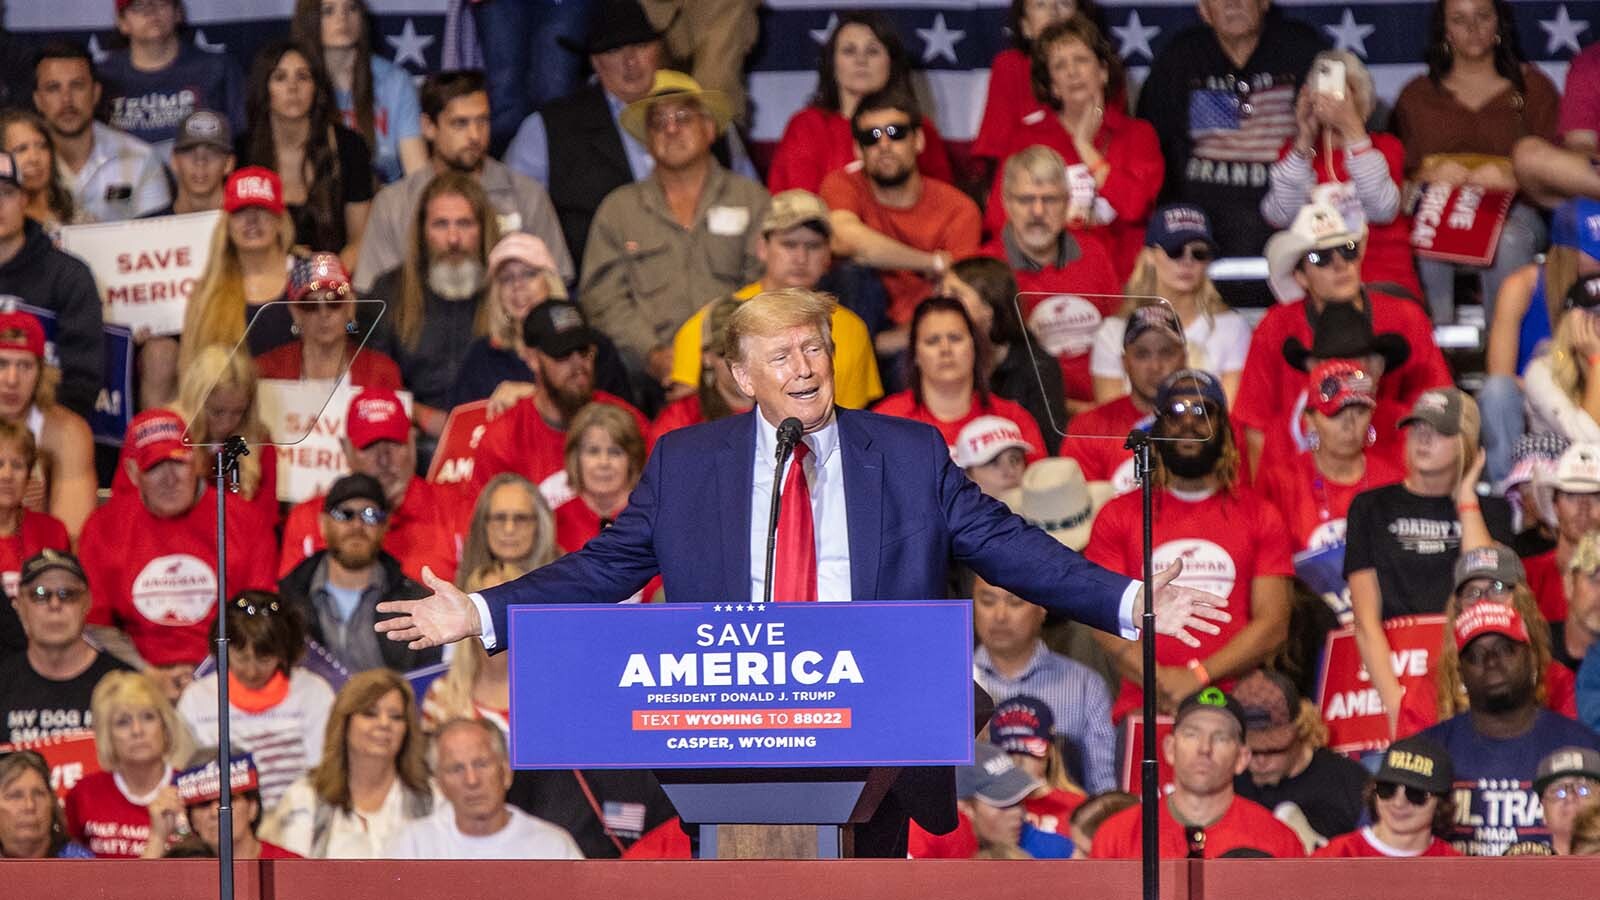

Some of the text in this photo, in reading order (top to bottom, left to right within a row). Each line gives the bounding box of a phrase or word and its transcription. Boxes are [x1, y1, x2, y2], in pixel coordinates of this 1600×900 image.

[1185, 158, 1268, 187] GRAND
[117, 247, 192, 274] SAVE
[107, 278, 196, 305] MERIC
[285, 412, 342, 436] SAV
[275, 446, 342, 470] MERI
[696, 622, 785, 647] SAVE
[618, 650, 865, 688] AMERICA
[647, 691, 836, 704] PRESIDENT DONALD J. TRUMP
[1326, 689, 1386, 720] AME
[8, 709, 37, 729] MY
[40, 709, 80, 728] DOG
[641, 713, 842, 726] TEXT WYOMING TO 88022
[666, 736, 817, 750] CASPER, WYOMING
[1475, 828, 1518, 842] MAGA
